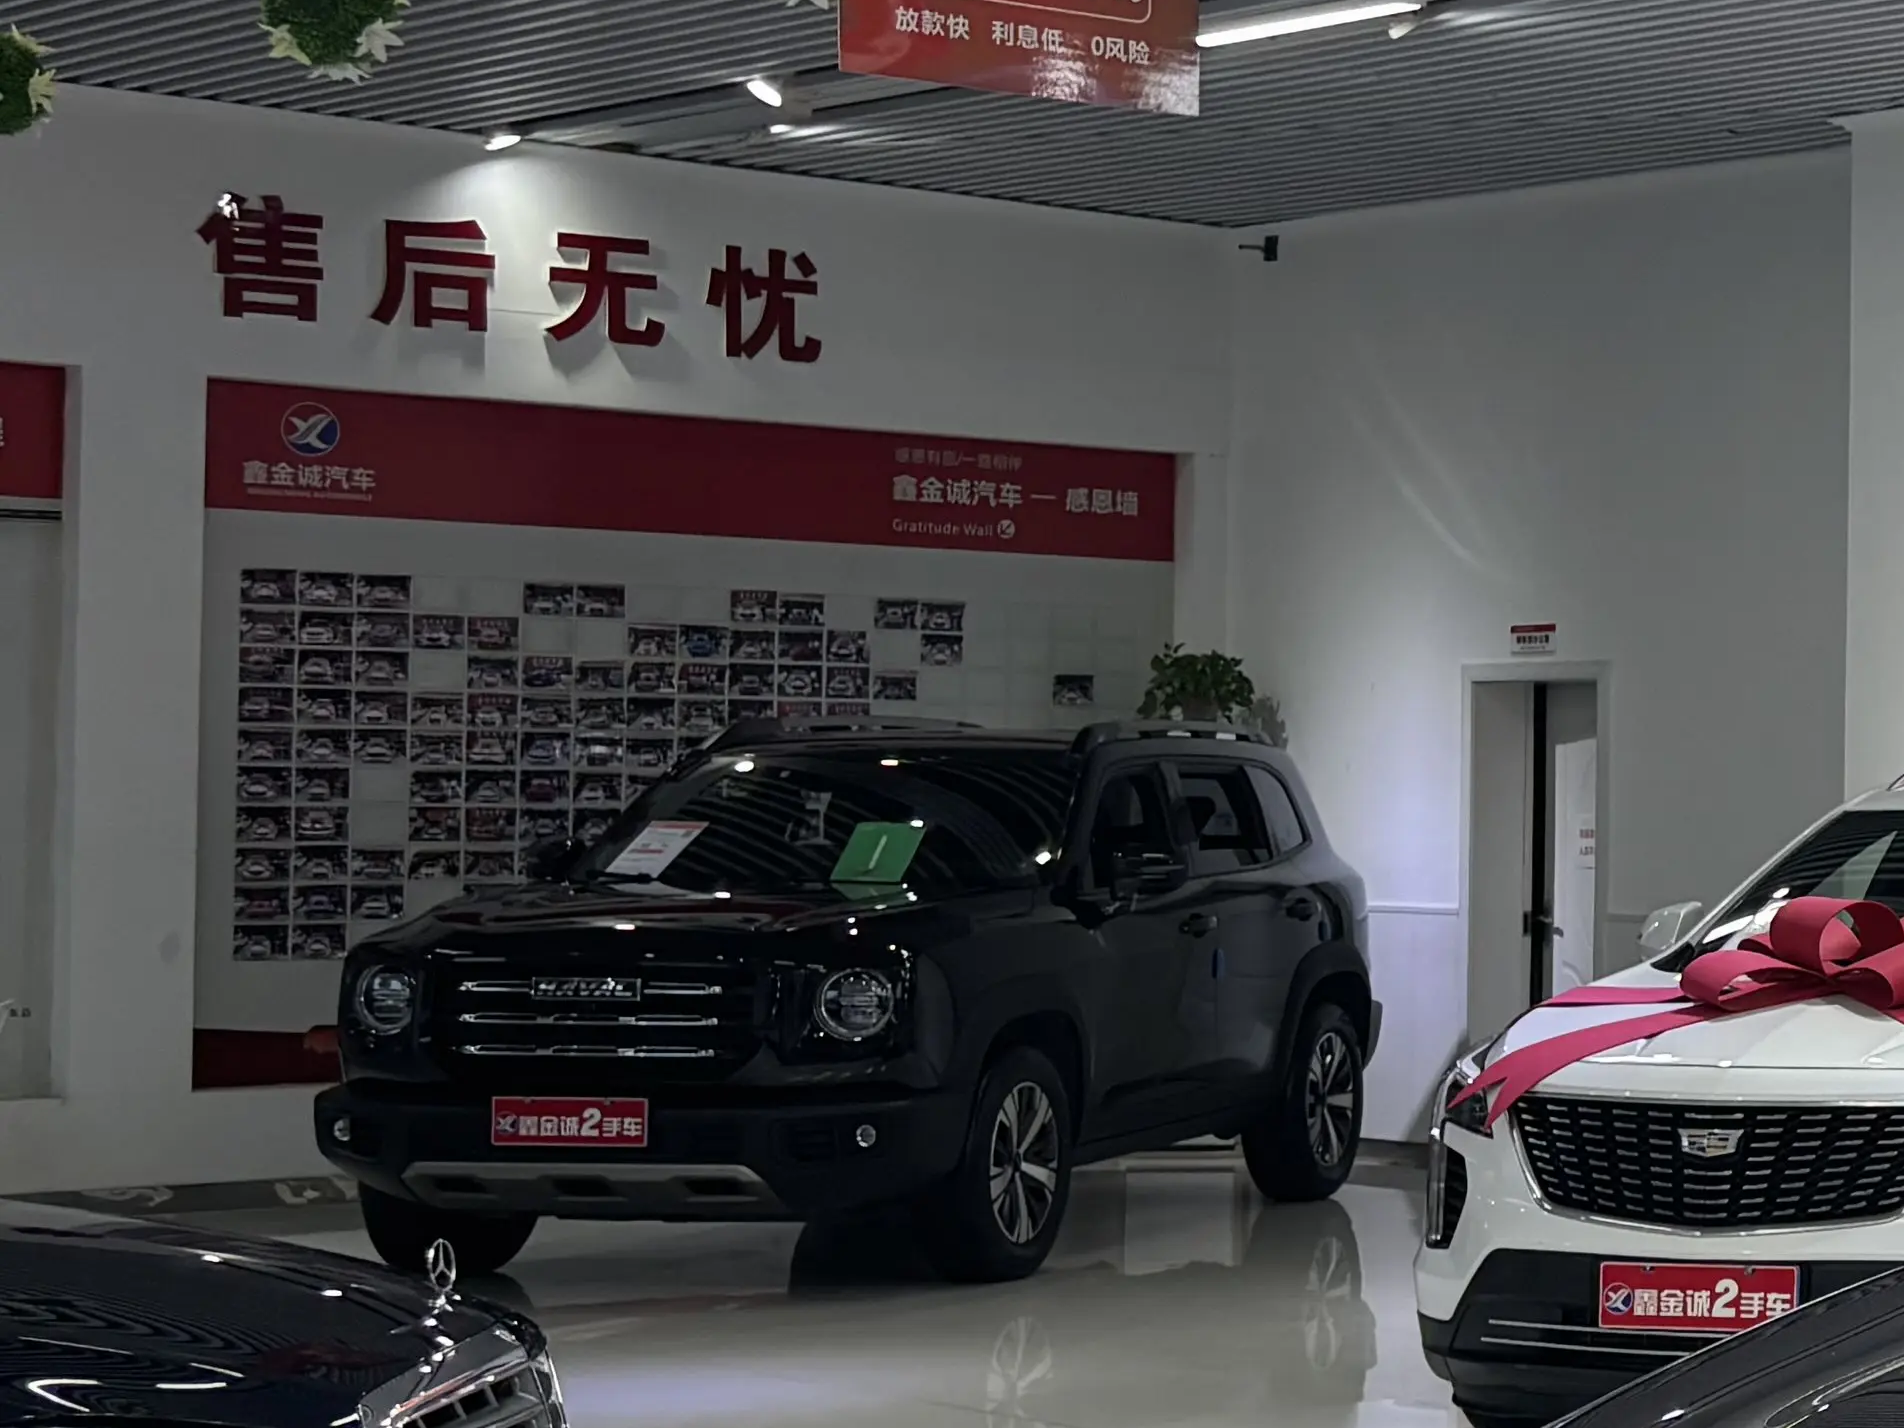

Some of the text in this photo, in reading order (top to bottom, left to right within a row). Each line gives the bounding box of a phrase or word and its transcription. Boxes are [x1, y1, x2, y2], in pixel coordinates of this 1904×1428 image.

[895, 6, 1151, 66] 放款快 利息低 0风险
[197, 191, 823, 364] 售后无忧
[243, 461, 377, 492] 鑫金诚汽车
[892, 474, 1024, 509] 鑫金诚汽车
[1066, 487, 1139, 517] 感恩墙
[892, 518, 993, 538] Gratitude Wall
[518, 1107, 643, 1138] 鑫金诚2手车
[1633, 1278, 1792, 1318] 鑫金诚2手车
